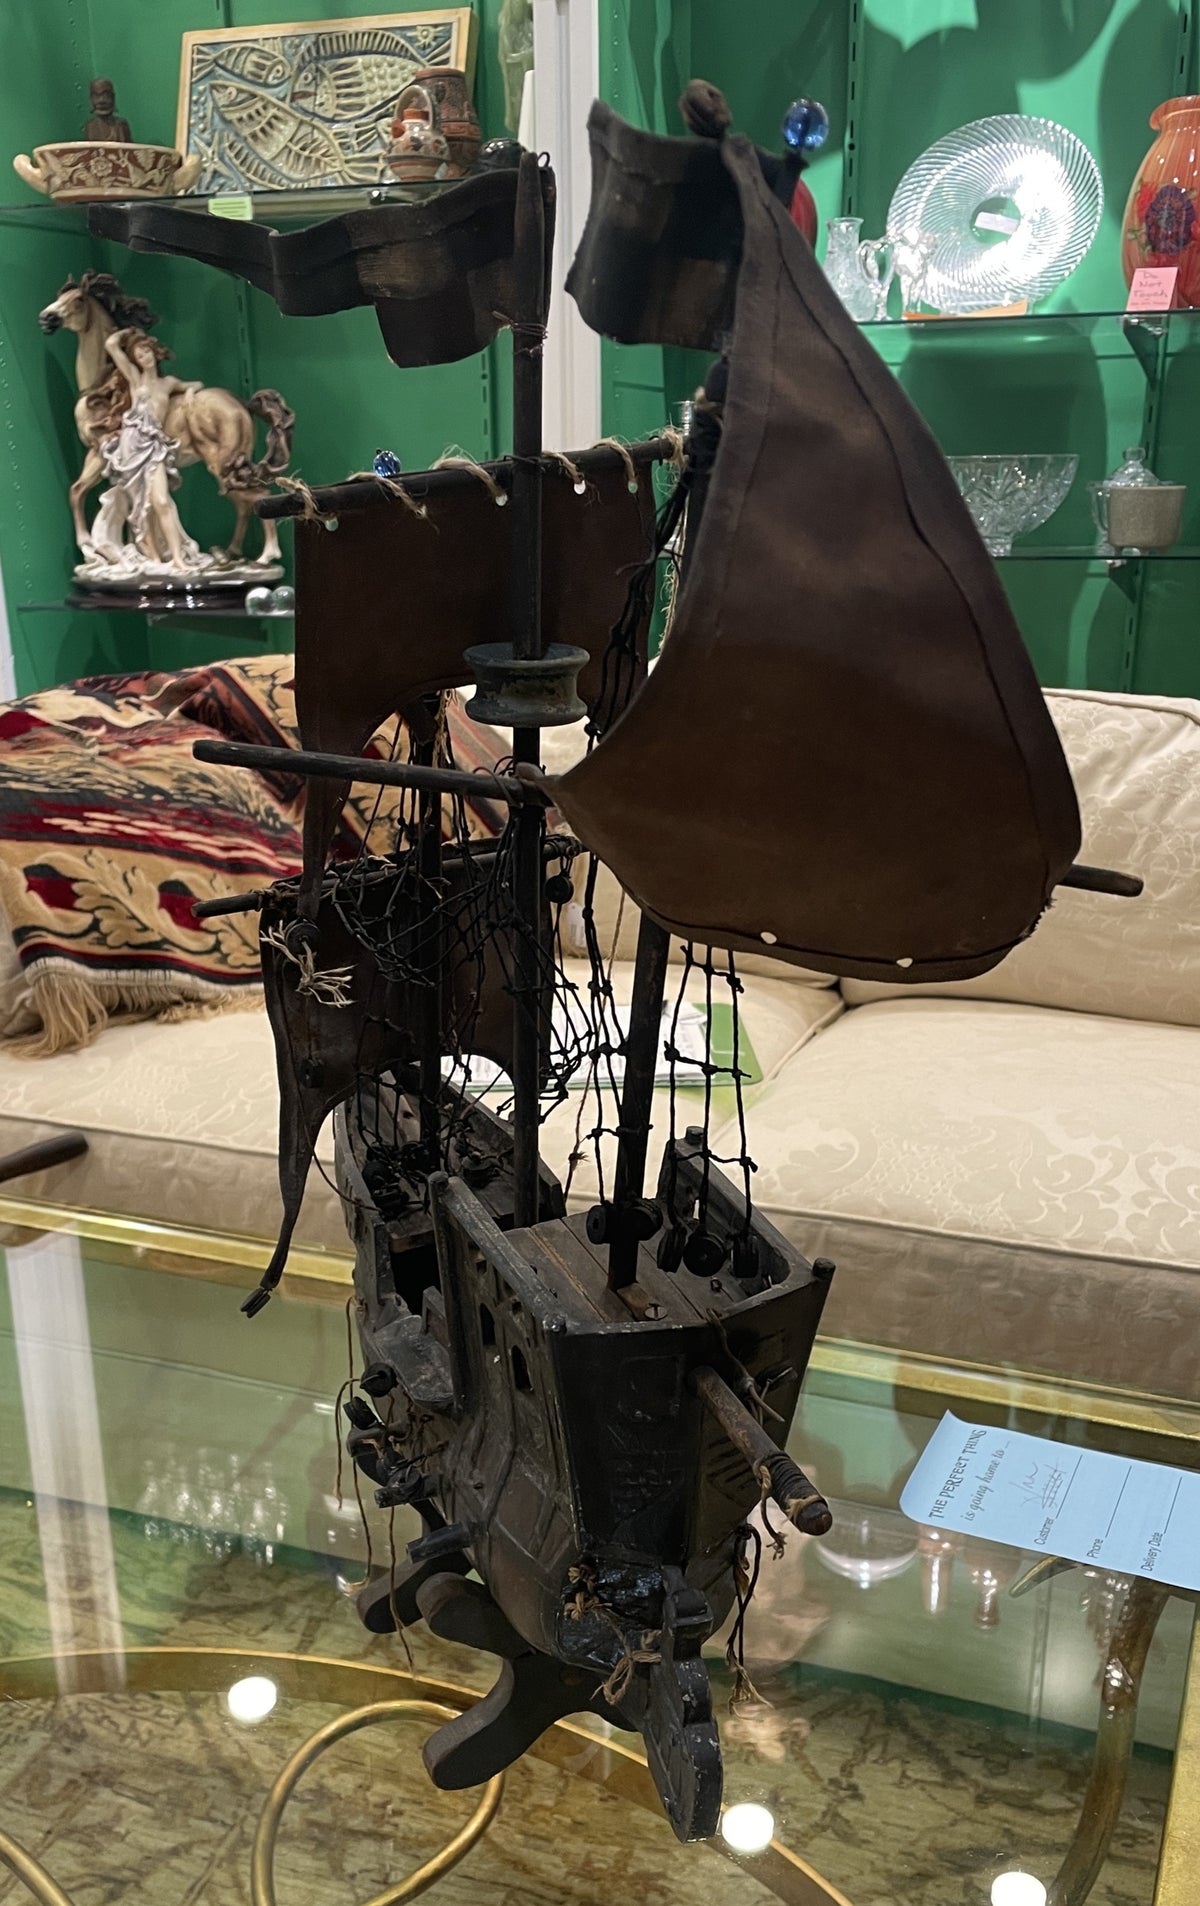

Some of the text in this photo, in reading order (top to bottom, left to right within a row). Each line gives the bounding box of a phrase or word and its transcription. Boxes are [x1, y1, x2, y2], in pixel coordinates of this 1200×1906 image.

[928, 1429, 987, 1518] THE PERFECT THING
[975, 1460, 1000, 1483] home
[969, 1485, 994, 1512] going
[960, 1511, 976, 1521] is
[1034, 1517, 1054, 1545] Customer
[1086, 1538, 1104, 1559] Phone
[1140, 1532, 1163, 1572] Delivery Date
